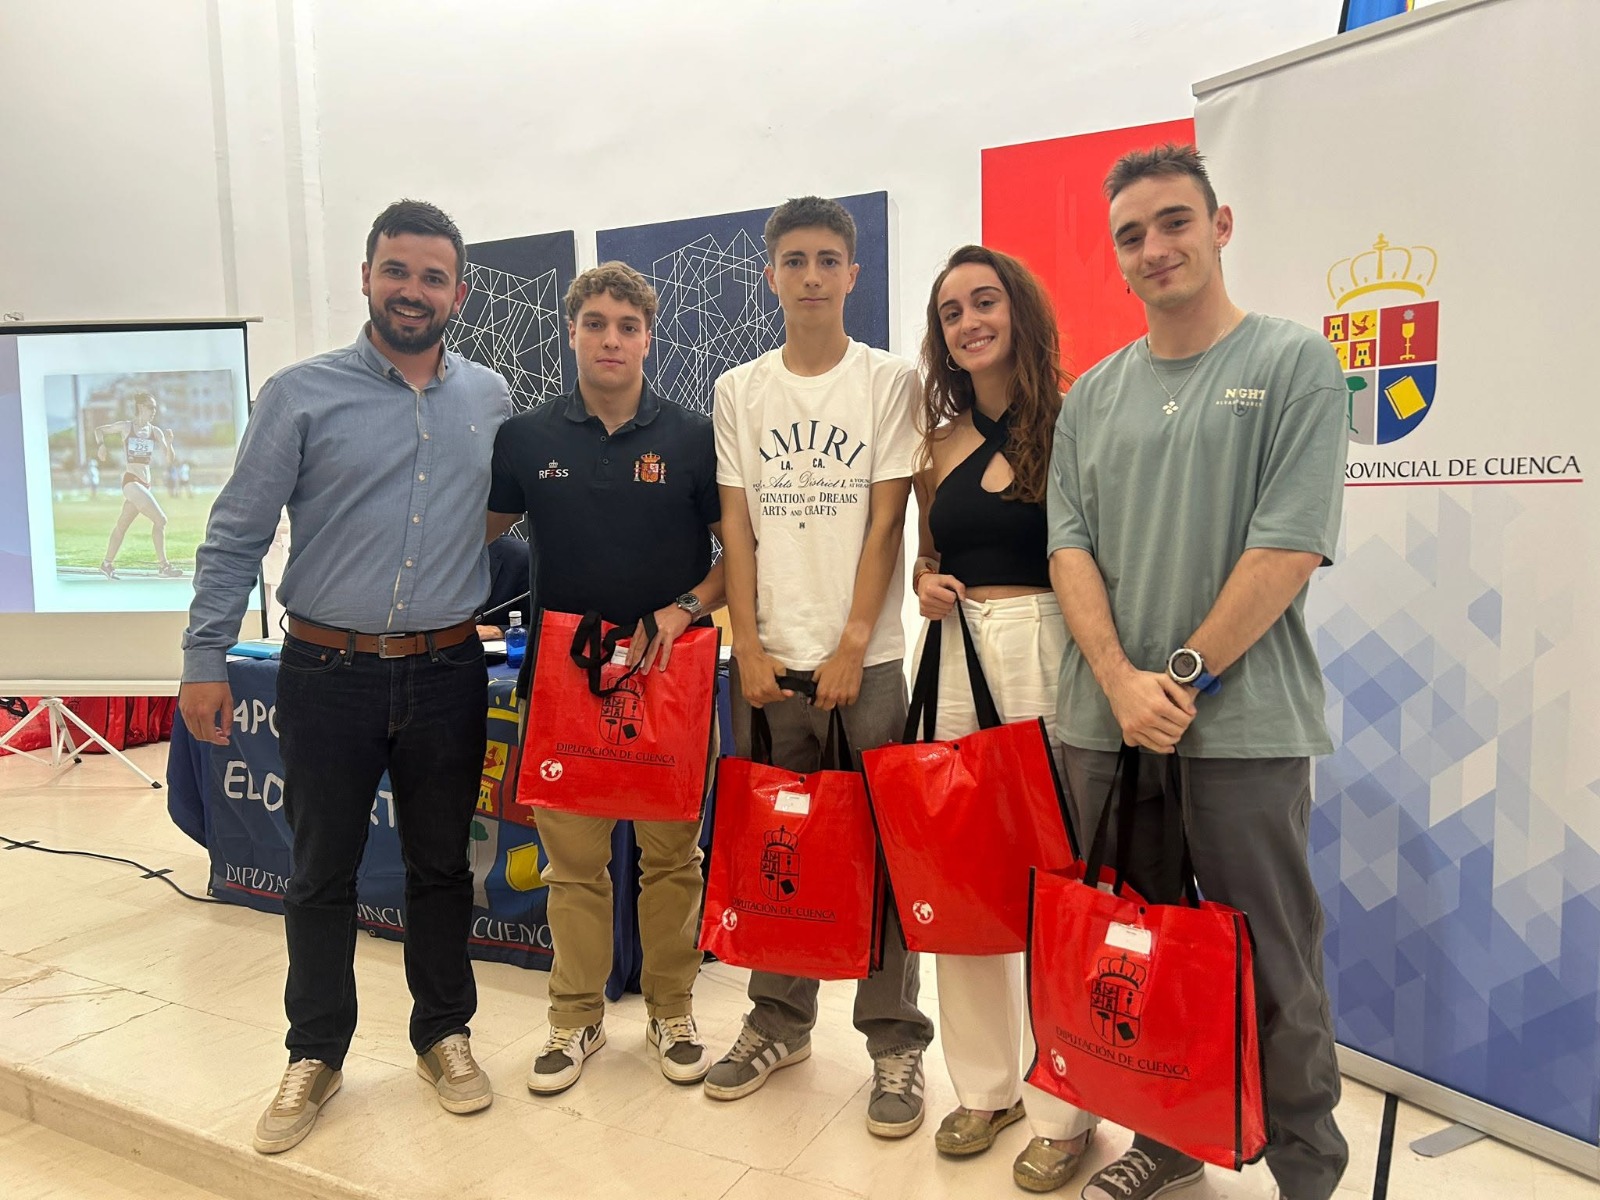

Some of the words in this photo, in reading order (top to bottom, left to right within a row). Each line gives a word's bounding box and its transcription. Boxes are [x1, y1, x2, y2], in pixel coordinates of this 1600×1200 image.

[1448, 458, 1477, 476] DE
[1484, 455, 1581, 475] CUENCA
[819, 492, 858, 503] DREAMS
[762, 506, 787, 516] ARTS
[804, 505, 837, 516] CRAFTS
[620, 749, 632, 760] DE
[636, 752, 675, 763] CUENCA
[780, 906, 793, 915] DE
[796, 908, 836, 919] CUENCA
[472, 916, 553, 949] CUENC
[1117, 1053, 1134, 1065] DE
[1137, 1059, 1190, 1077] CUENCA
